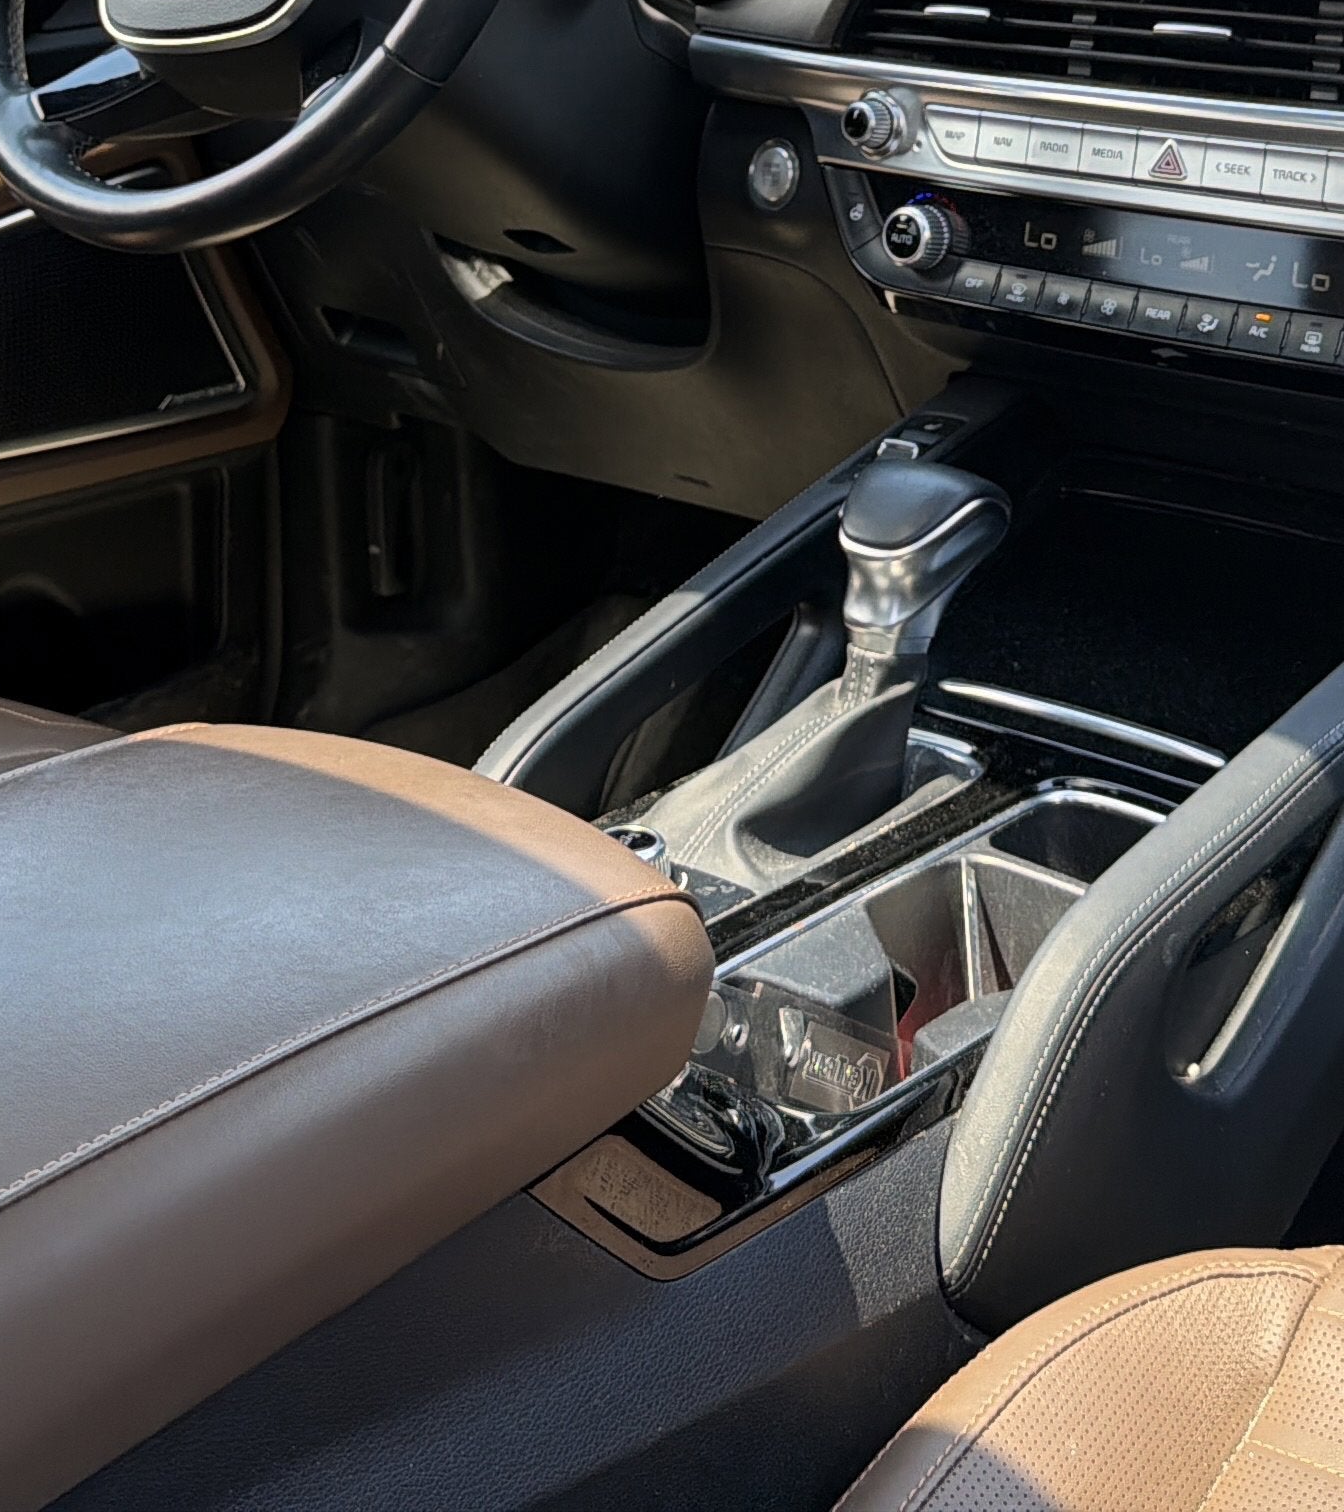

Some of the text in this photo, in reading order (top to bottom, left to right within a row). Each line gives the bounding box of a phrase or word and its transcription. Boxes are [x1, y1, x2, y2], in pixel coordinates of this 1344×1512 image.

[944, 130, 965, 141] MAP
[993, 136, 1013, 147] NAV
[1039, 141, 1068, 154] RADIO
[1091, 147, 1124, 160] MEDIA
[890, 232, 913, 245] AUTO
[965, 277, 984, 288] OFF
[1145, 307, 1172, 321] REAR
[1248, 326, 1269, 339] A/C
[1299, 344, 1320, 354] REAR
